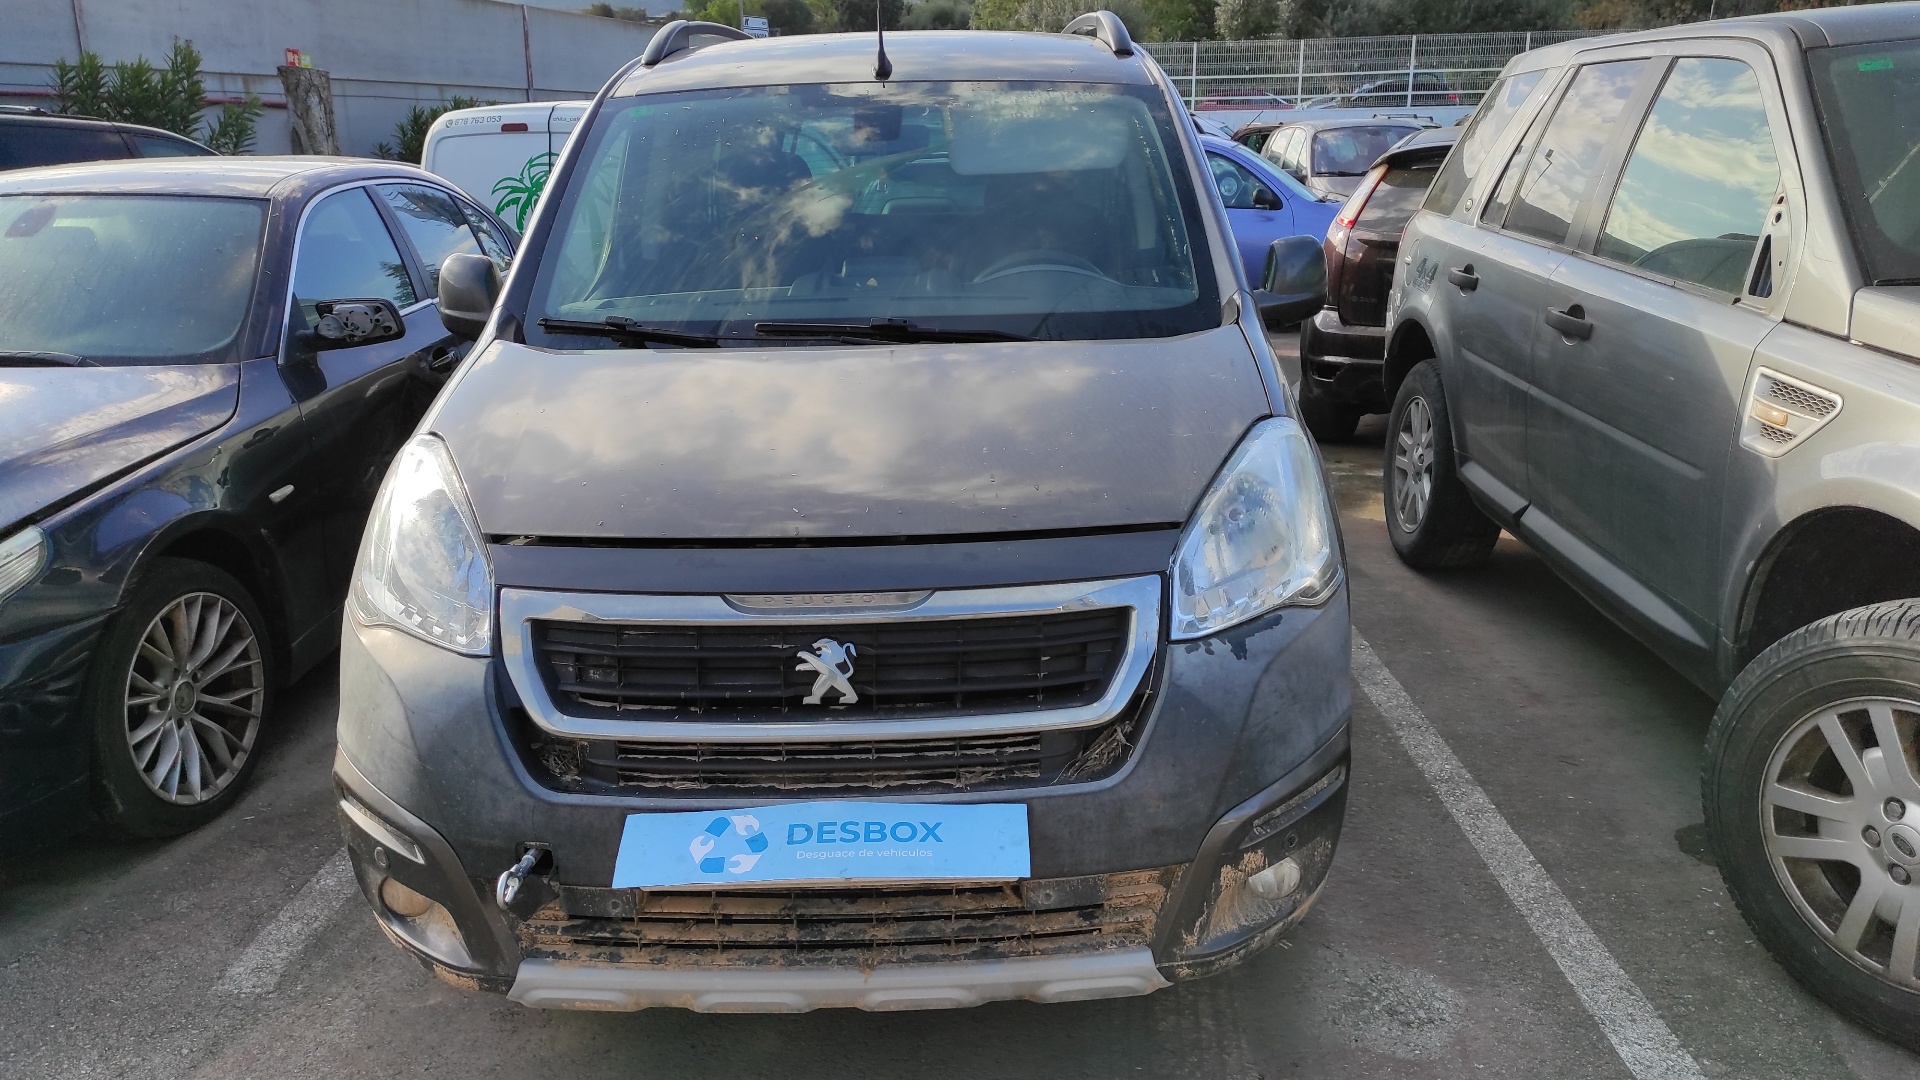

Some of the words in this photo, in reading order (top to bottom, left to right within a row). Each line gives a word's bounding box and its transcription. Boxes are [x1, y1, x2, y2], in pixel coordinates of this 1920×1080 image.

[486, 115, 502, 123] 053
[763, 594, 893, 605] PEUGEOT
[786, 821, 944, 846] DESBOX
[796, 849, 856, 860] Desguace
[858, 848, 873, 858] de
